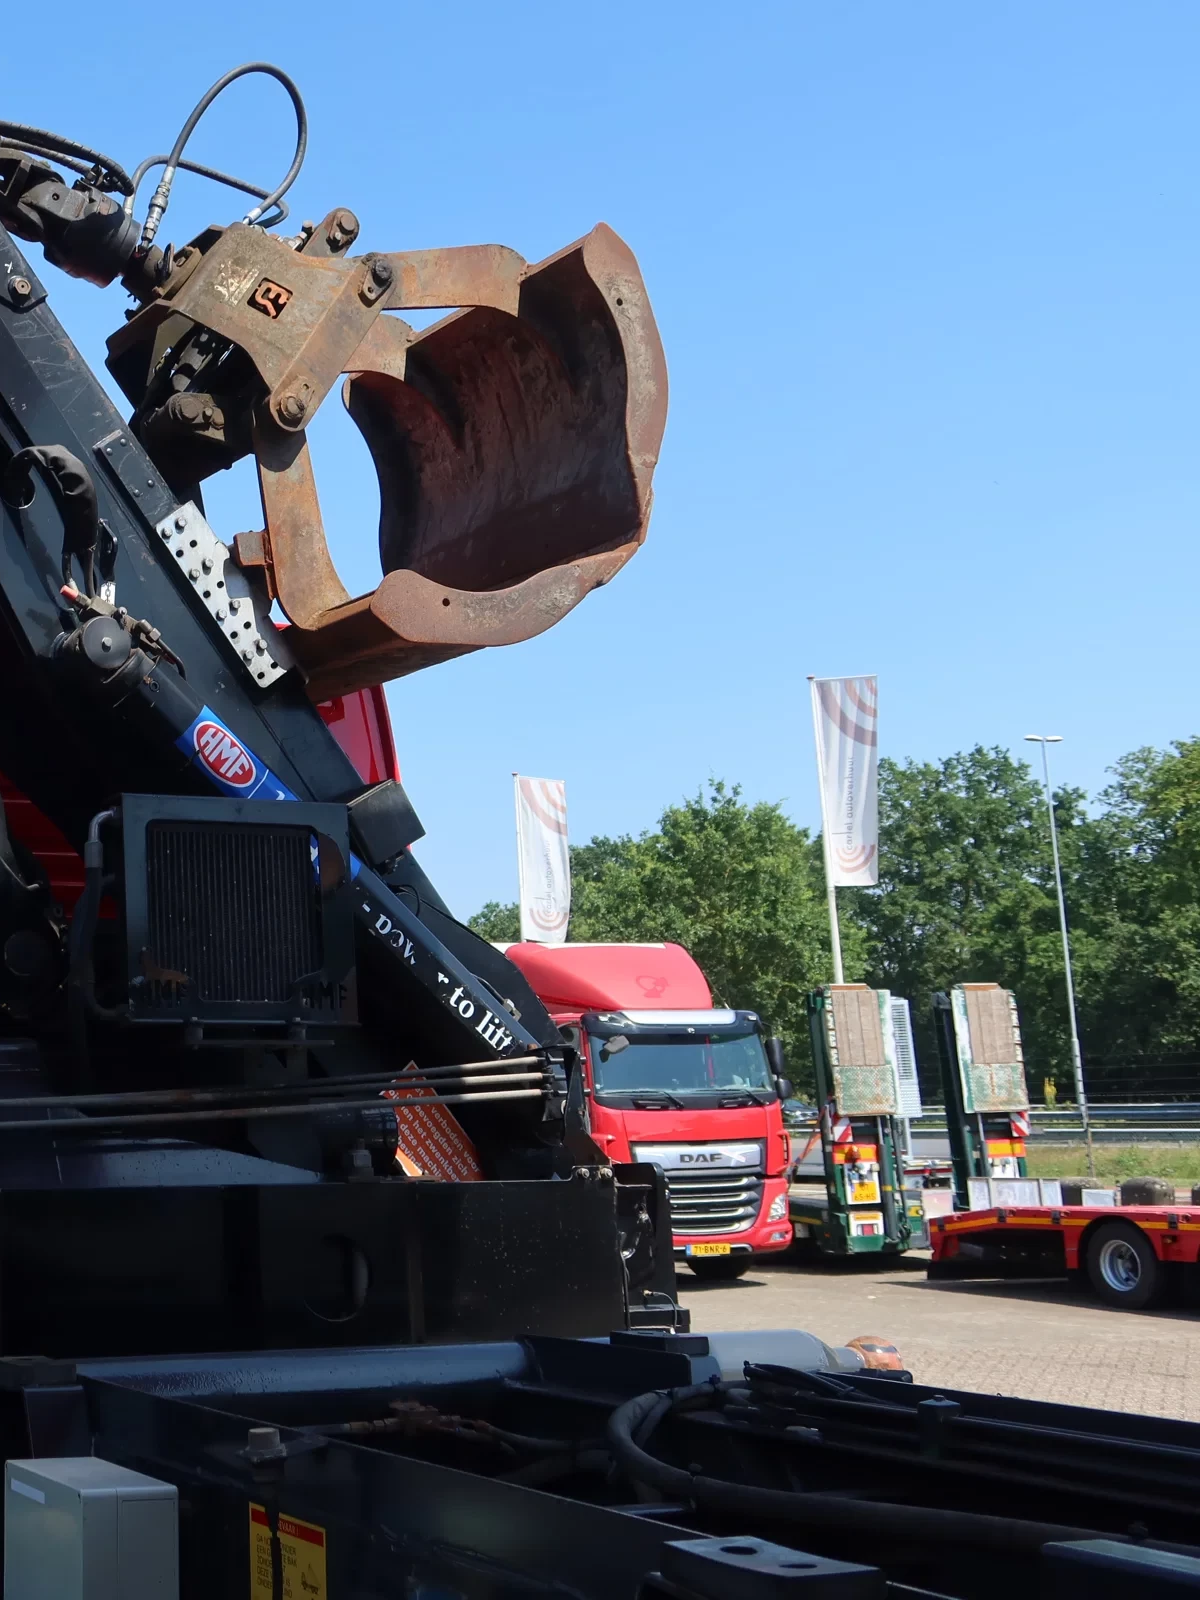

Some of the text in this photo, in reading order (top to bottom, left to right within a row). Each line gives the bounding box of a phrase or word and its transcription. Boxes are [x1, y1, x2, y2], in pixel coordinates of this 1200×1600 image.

[200, 728, 250, 779] HMF
[448, 986, 476, 1020] to
[399, 1123, 418, 1147] deze
[413, 1119, 427, 1139] het
[431, 1106, 465, 1151] verboden
[463, 1150, 481, 1173] voor
[451, 1155, 469, 1177] zich
[679, 1153, 723, 1163] DAF
[693, 1245, 728, 1255] 71-BNR-6
[277, 1520, 296, 1535] EVAAR
[282, 1543, 297, 1556] NDER
